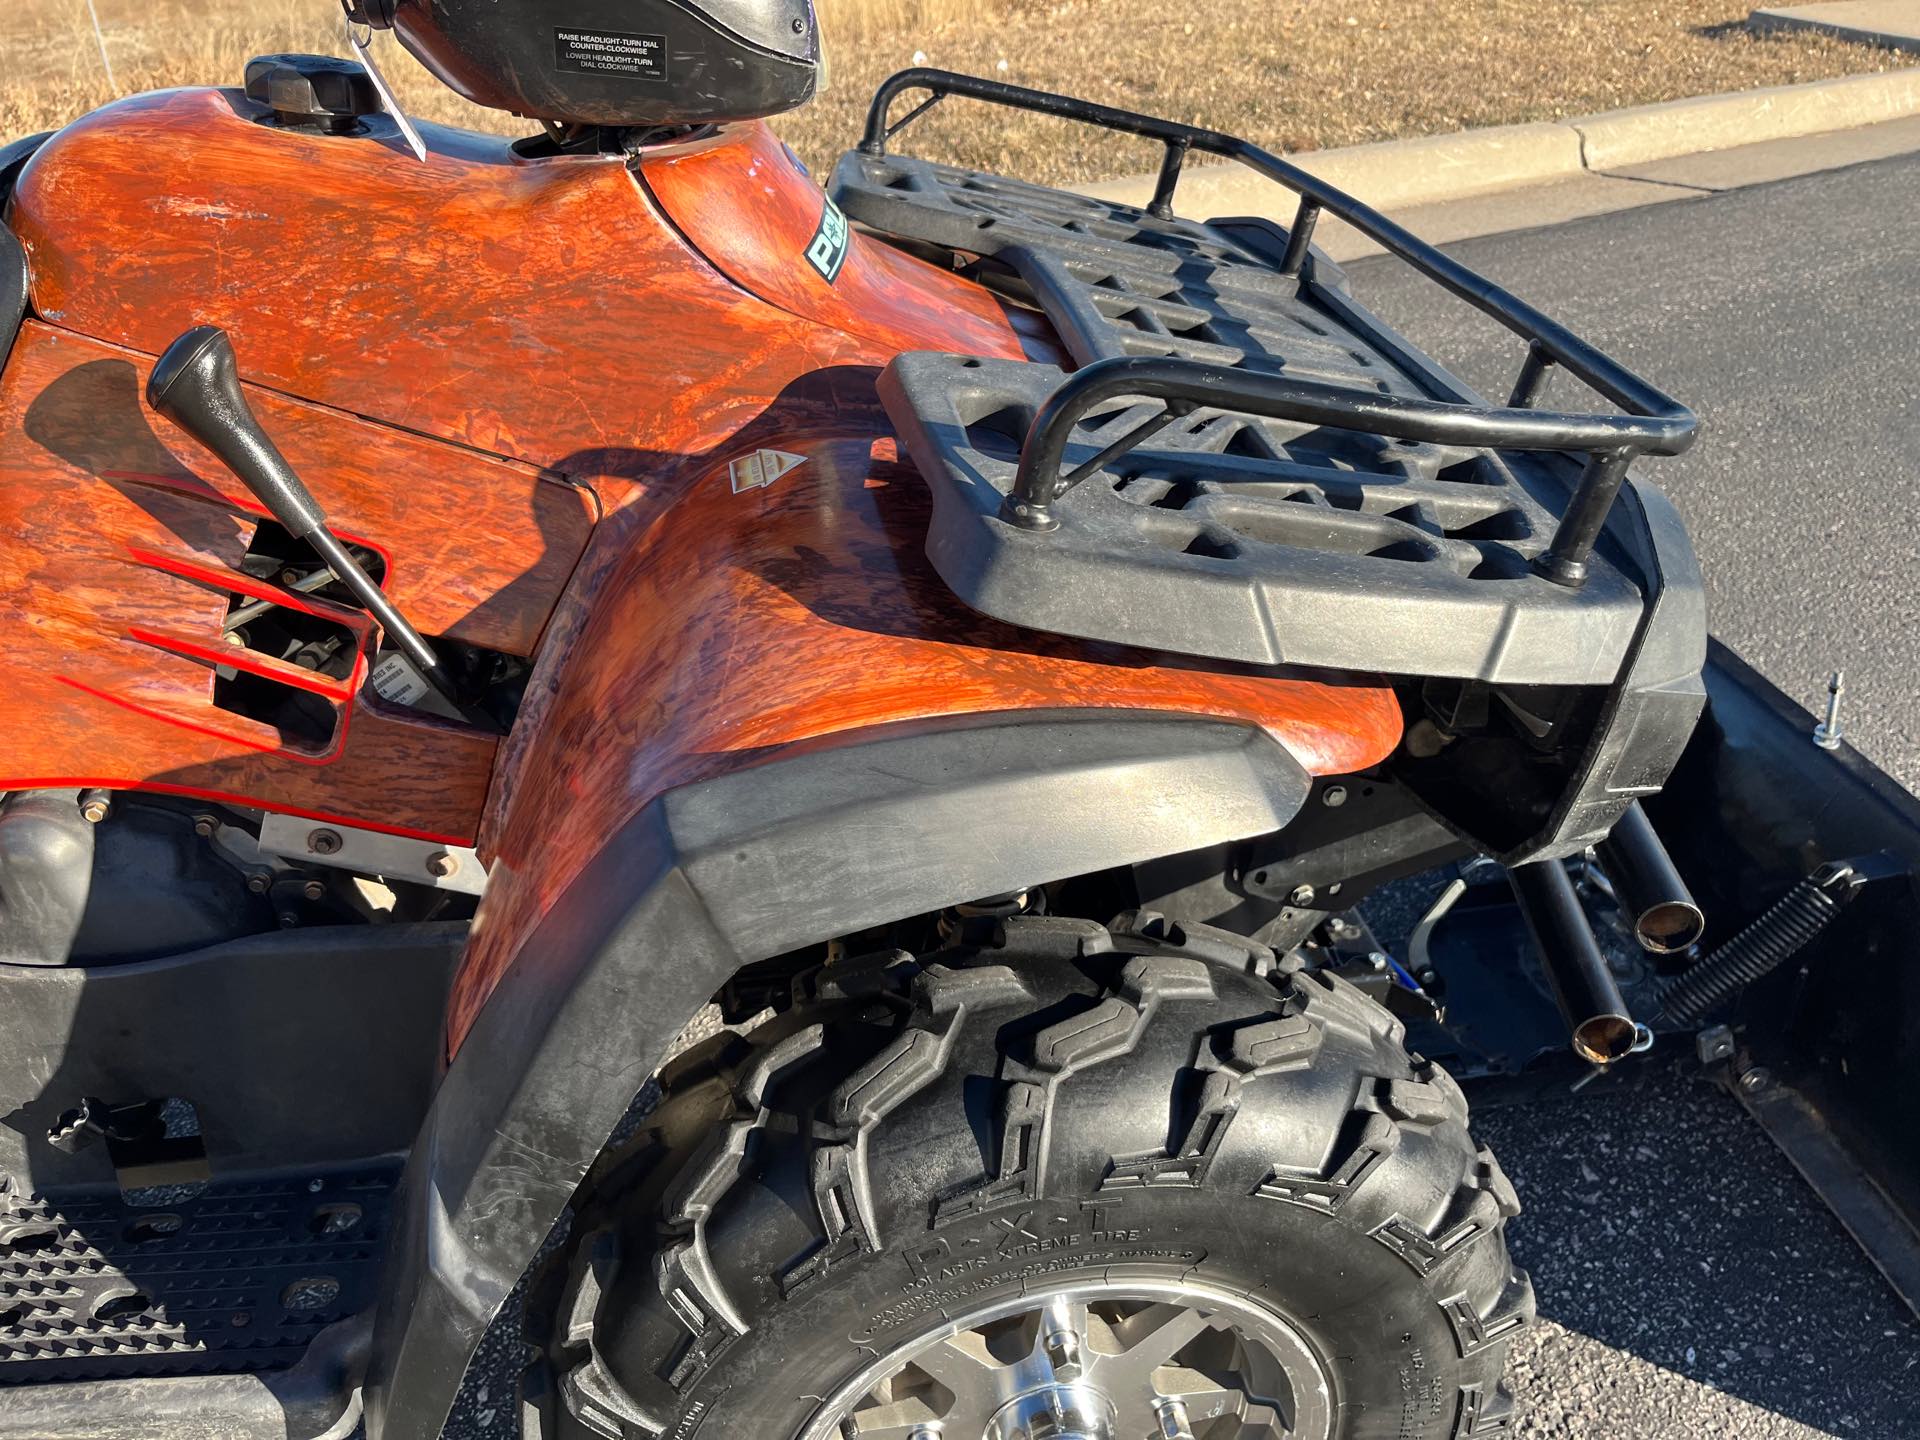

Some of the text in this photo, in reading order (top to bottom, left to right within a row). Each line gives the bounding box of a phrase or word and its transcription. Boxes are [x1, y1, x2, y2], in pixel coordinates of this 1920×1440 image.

[558, 33, 660, 49] RAISE HEADLIGHT-TURN DIAL
[569, 41, 648, 55] COUNTER-CLOCKWISE
[565, 52, 653, 66] LOWER HEADLIGHT-TURN
[580, 60, 597, 68] DIAL
[597, 62, 639, 73] CLOCKWISE
[997, 1234, 1081, 1262] XTREME
[1091, 1229, 1141, 1244] TIRE
